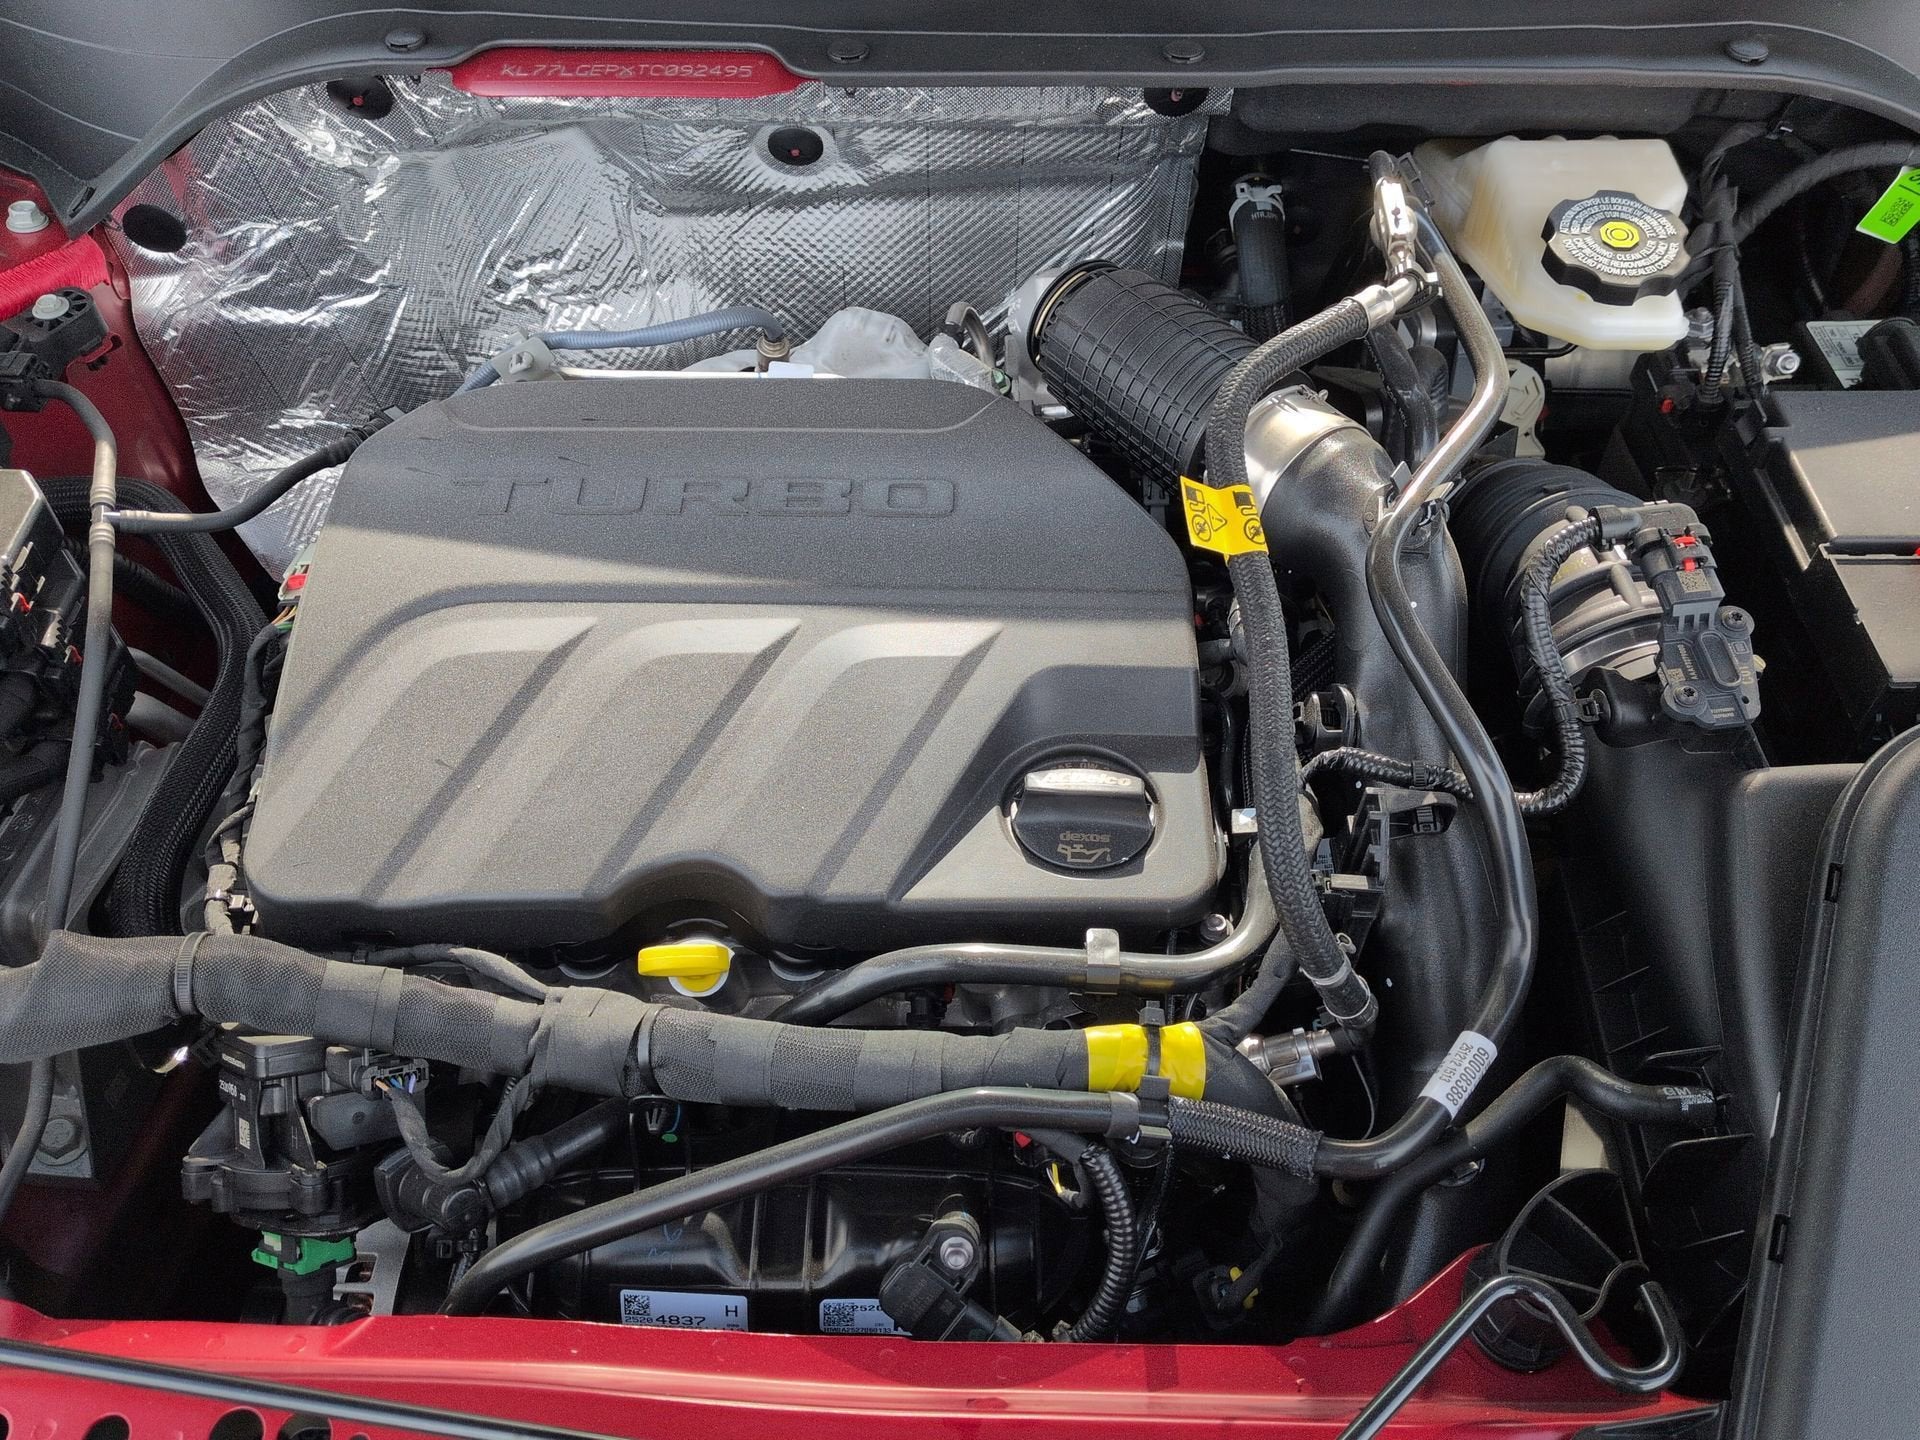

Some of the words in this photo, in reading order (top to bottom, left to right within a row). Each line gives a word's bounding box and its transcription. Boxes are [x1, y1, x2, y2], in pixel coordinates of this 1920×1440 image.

[452, 476, 956, 518] TURBO
[1059, 831, 1111, 843] dexos
[1445, 1047, 1490, 1106] 60008388
[725, 1304, 738, 1317] H
